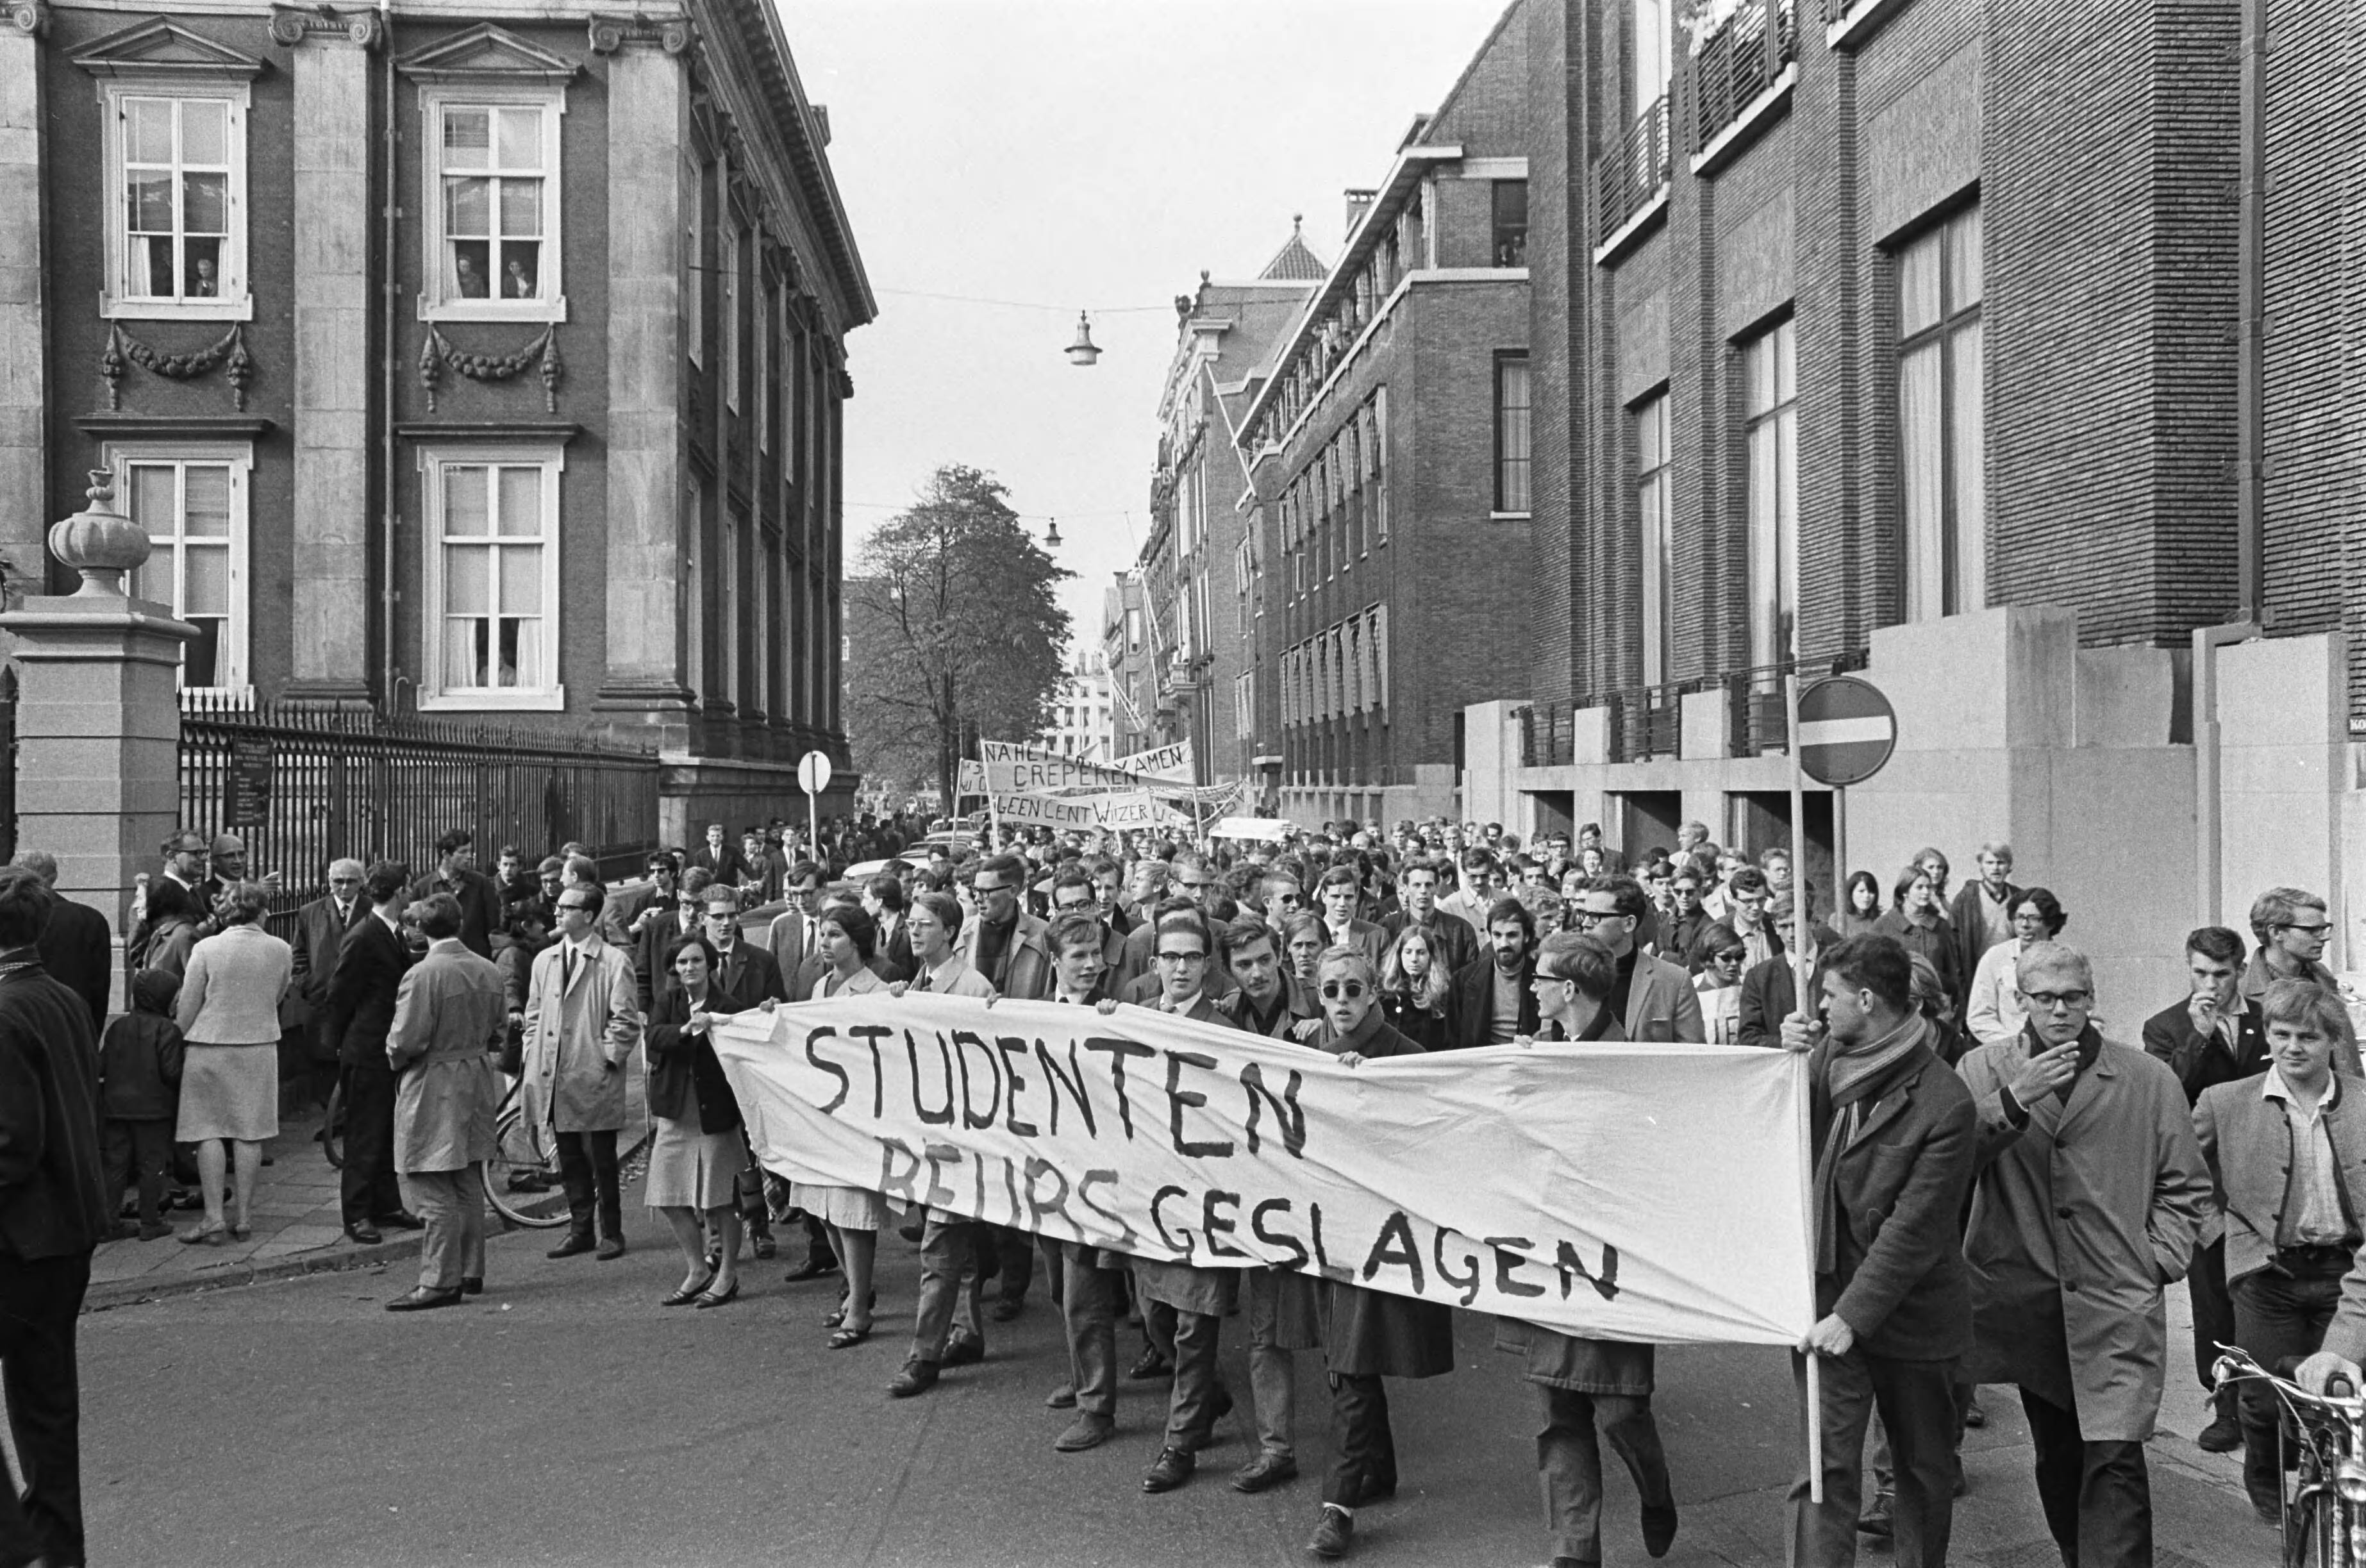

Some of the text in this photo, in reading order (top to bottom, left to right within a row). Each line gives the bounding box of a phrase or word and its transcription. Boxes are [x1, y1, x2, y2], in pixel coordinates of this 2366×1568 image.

[1013, 763, 1139, 787] CREPEREN
[997, 795, 1040, 818] GEEN
[1044, 799, 1092, 824] CENT
[805, 1025, 1306, 1159] STUDENTEN
